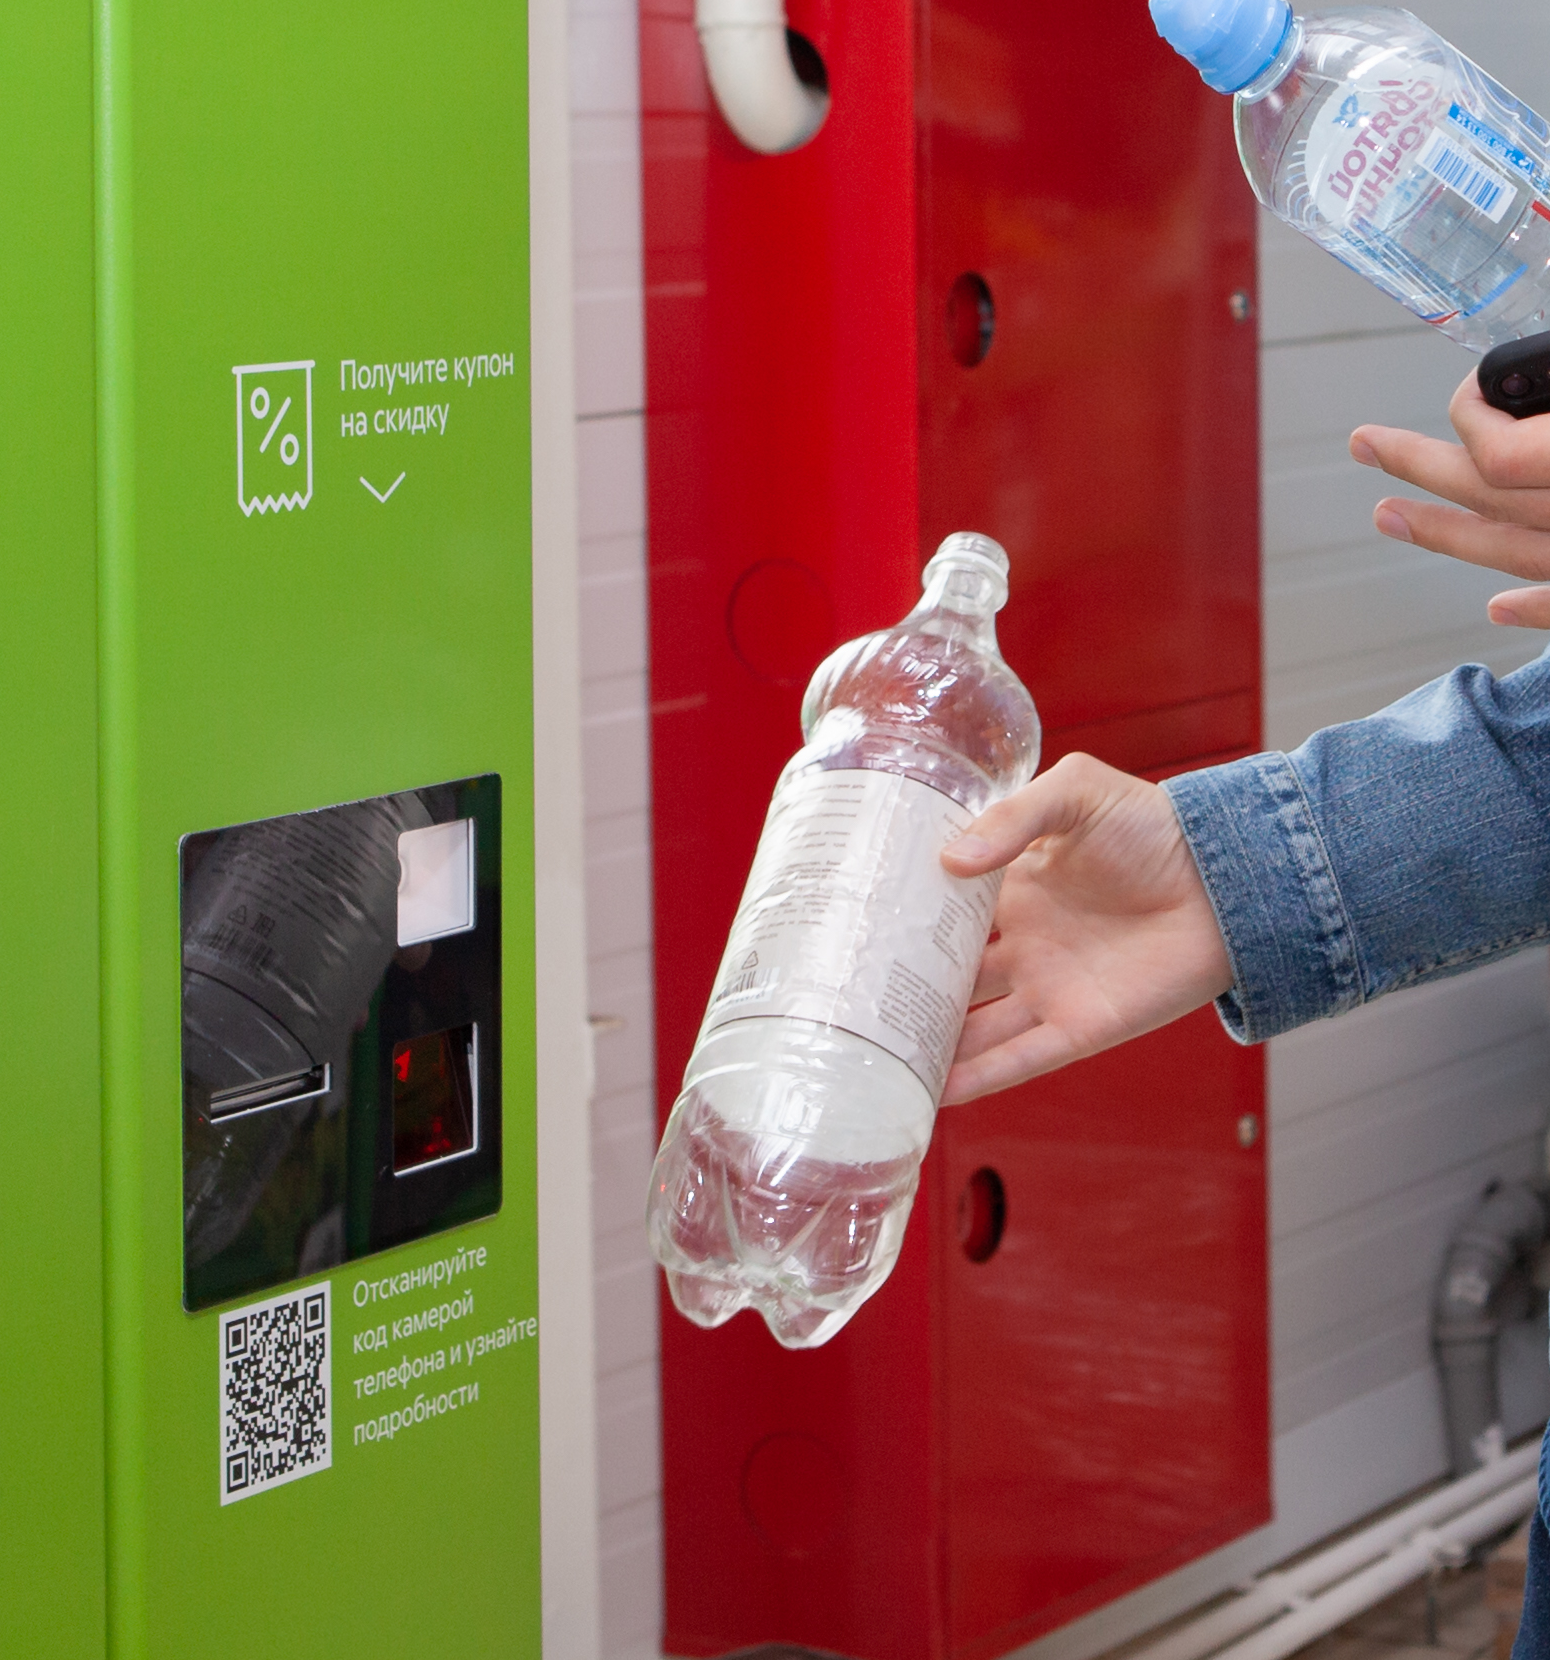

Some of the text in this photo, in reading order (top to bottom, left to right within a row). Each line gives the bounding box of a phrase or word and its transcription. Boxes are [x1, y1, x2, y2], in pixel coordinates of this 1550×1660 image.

[340, 352, 514, 395] Получите купон
[340, 403, 449, 437] на скидку
[353, 1246, 487, 1307] Отсканируйте
[353, 1289, 473, 1355] код камерой
[353, 1317, 537, 1400] телефона и узнайте
[353, 1382, 479, 1446] подробности
